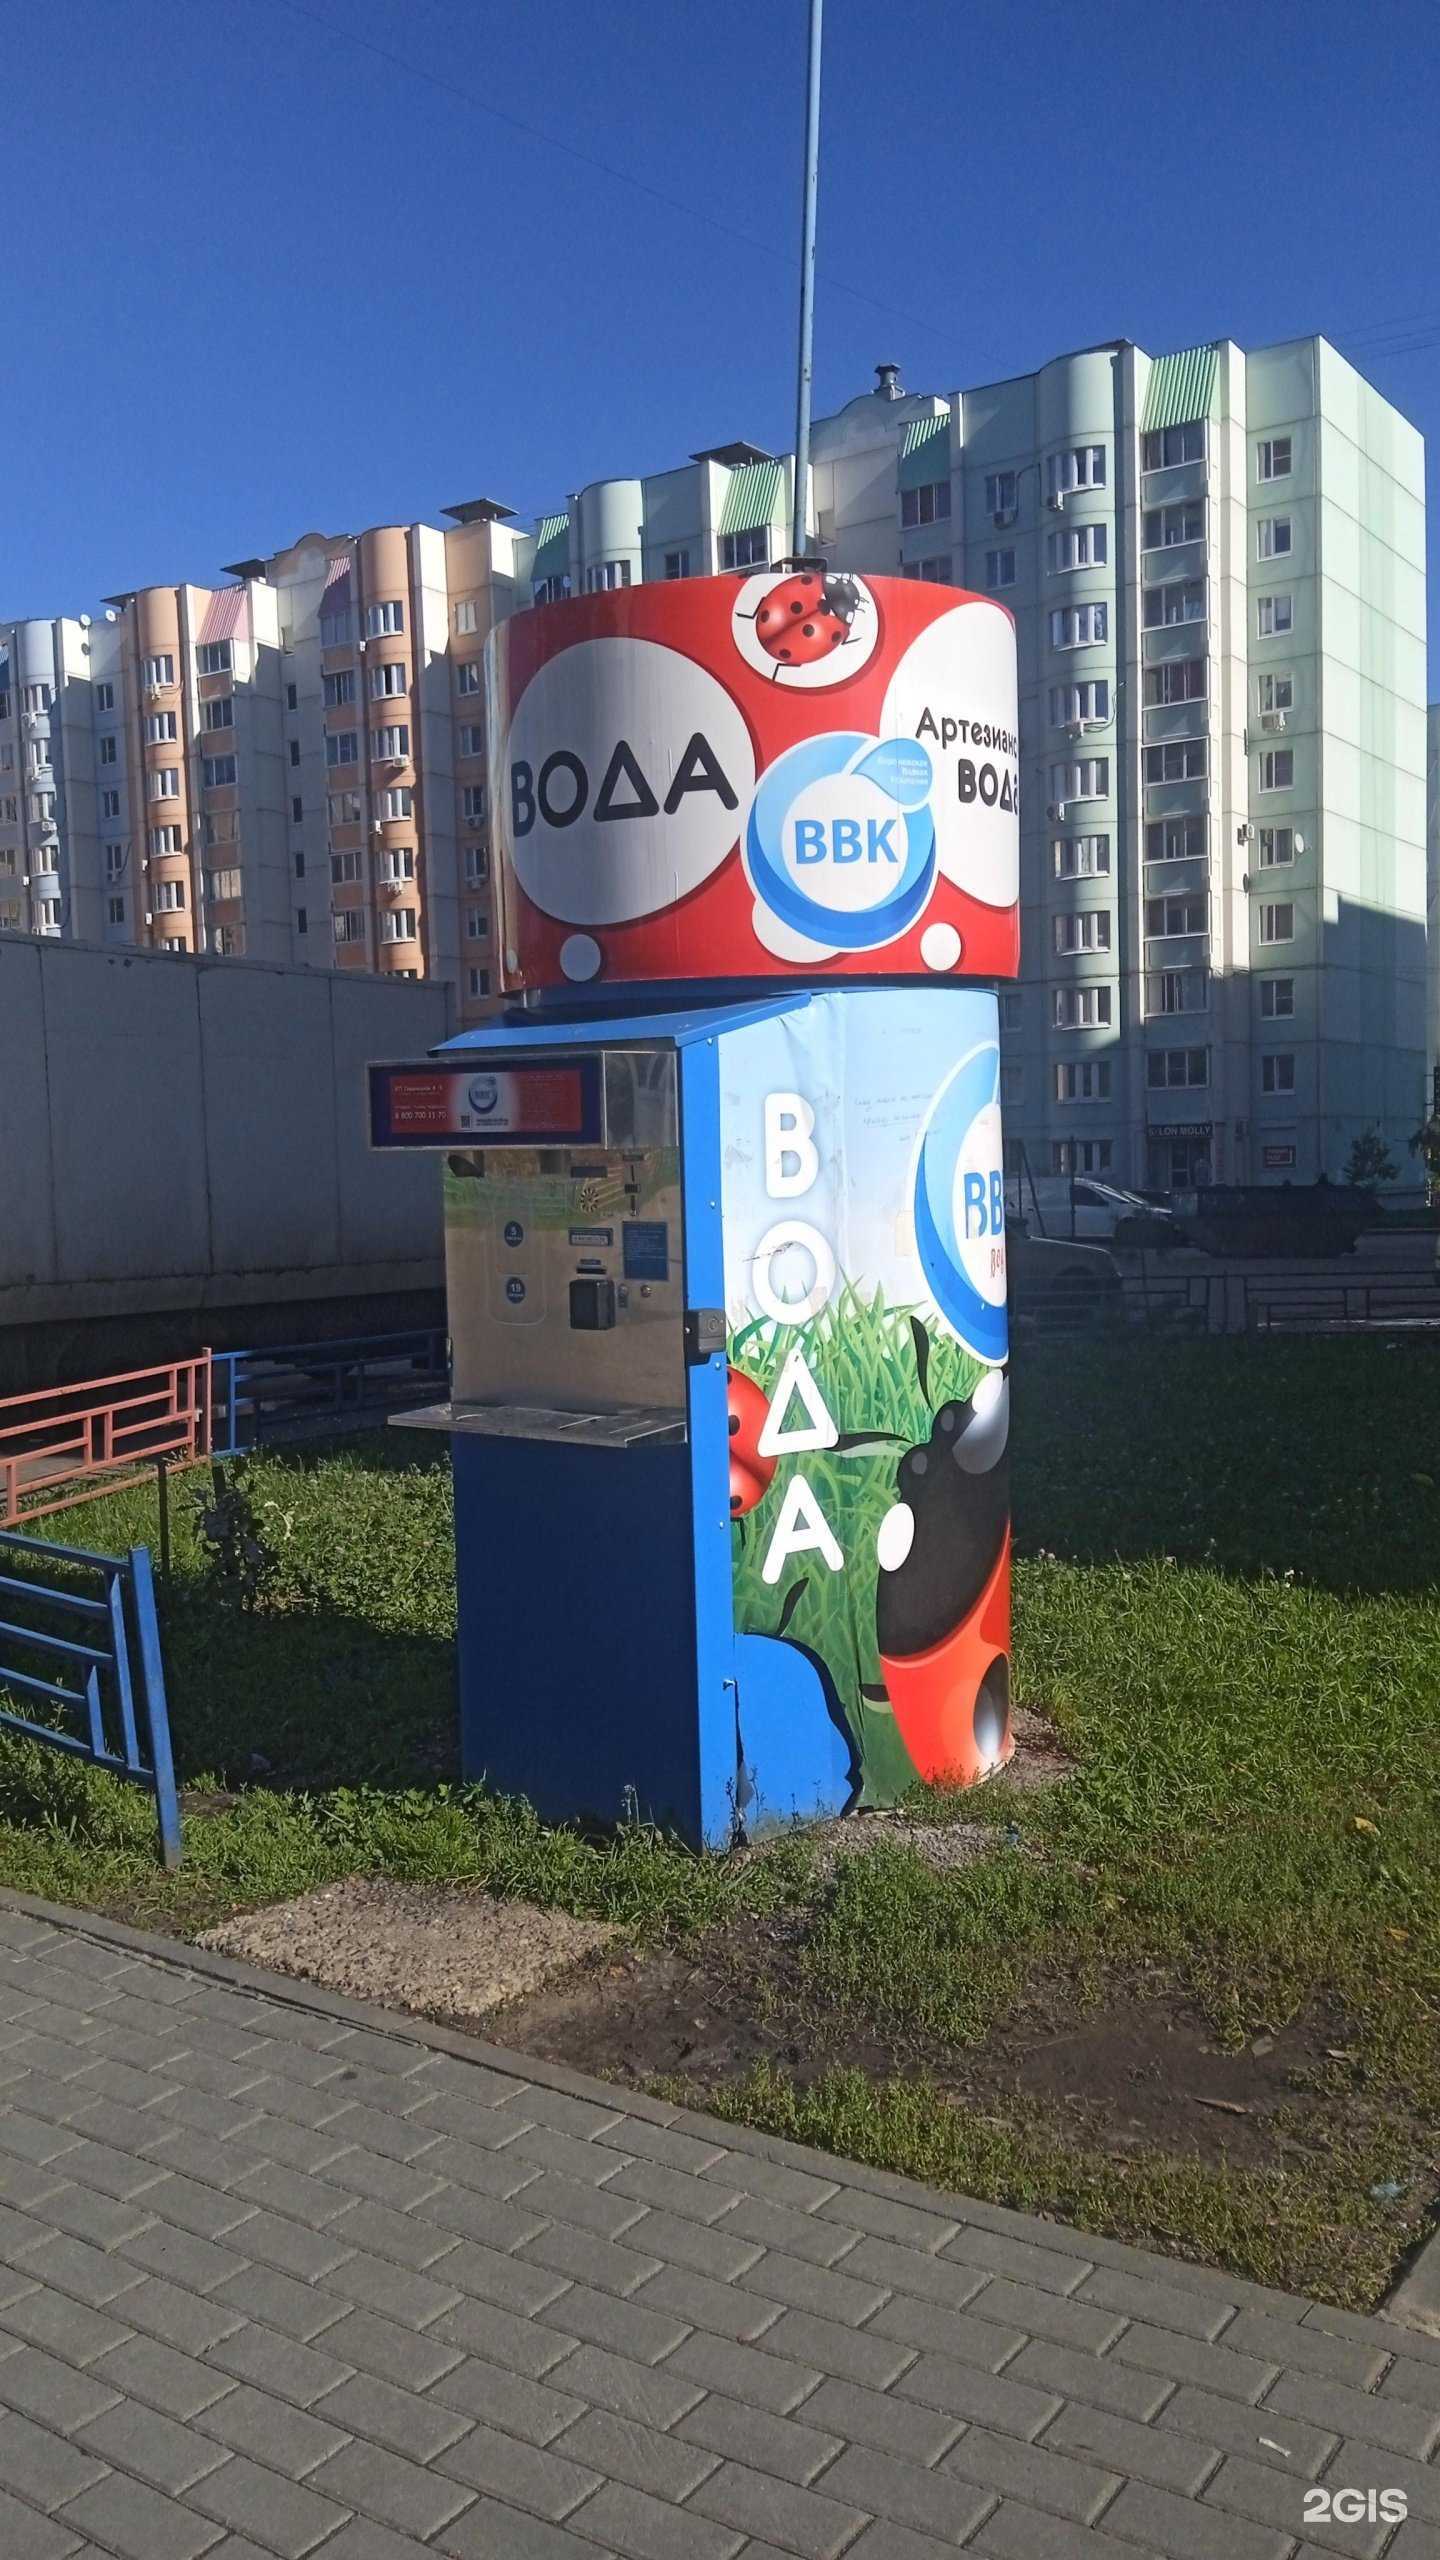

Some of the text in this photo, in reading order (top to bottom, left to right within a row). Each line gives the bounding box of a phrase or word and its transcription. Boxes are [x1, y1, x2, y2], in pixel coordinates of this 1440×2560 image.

[511, 731, 740, 838] ВОДА
[794, 818, 898, 865] ВВК
[1180, 1125, 1211, 1135] MOLLY
[752, 1092, 844, 1585] ВОДА
